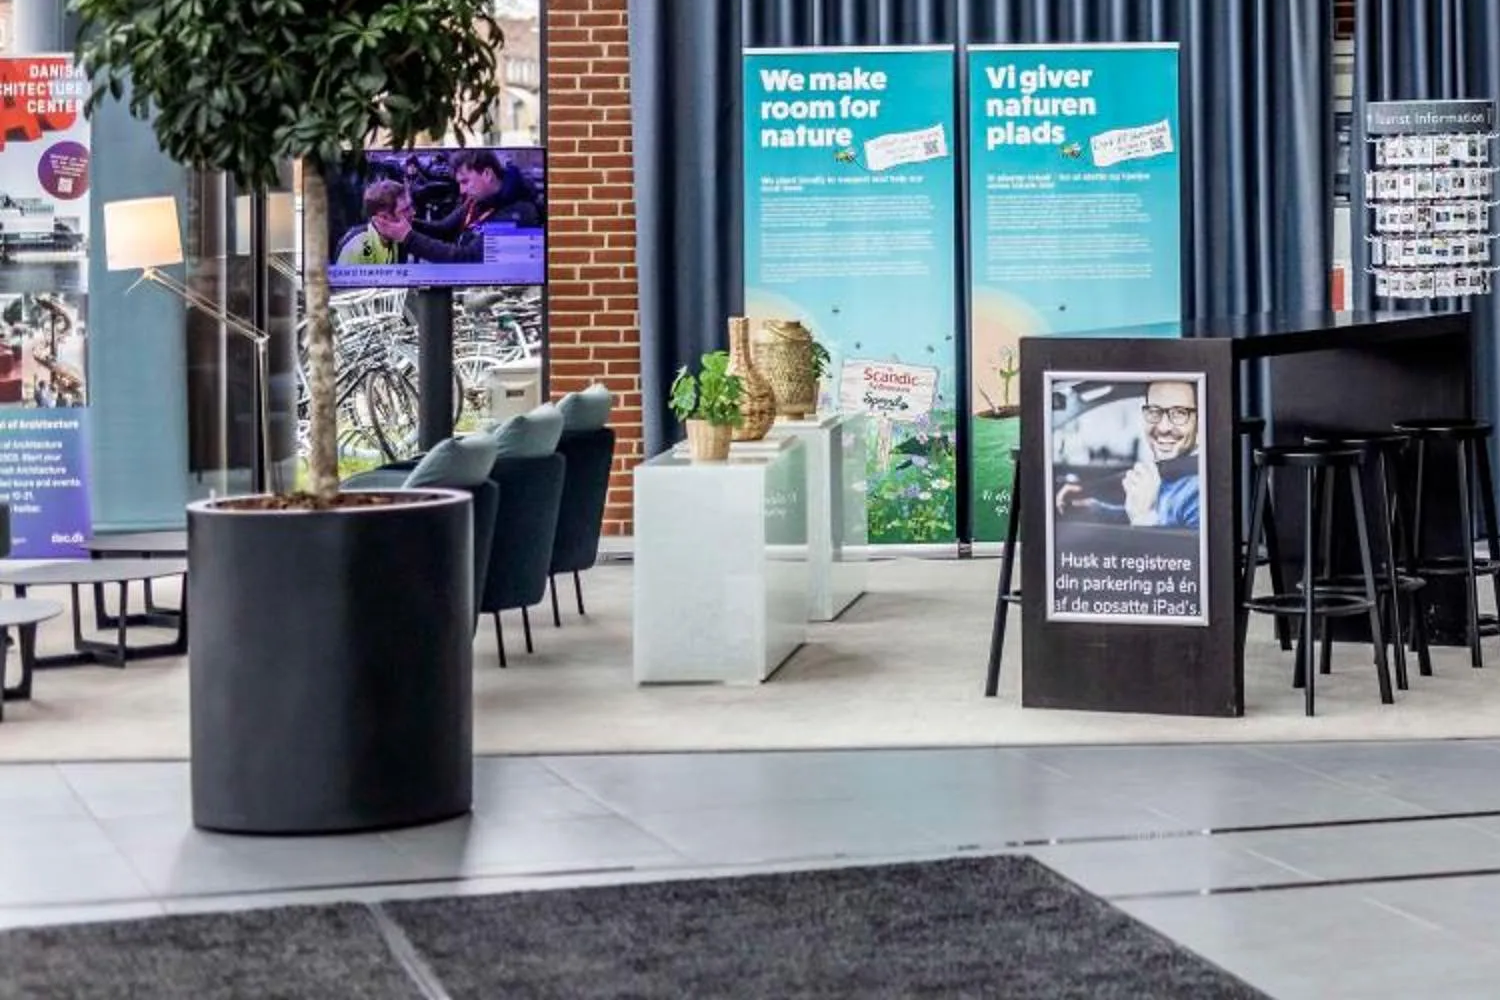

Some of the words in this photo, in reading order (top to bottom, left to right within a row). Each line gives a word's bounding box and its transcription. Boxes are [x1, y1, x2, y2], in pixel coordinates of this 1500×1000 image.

[30, 64, 84, 78] DANISH
[760, 69, 805, 92] We
[809, 67, 888, 91] make
[984, 64, 1016, 89] Vi
[1020, 64, 1093, 94] giver
[0, 82, 83, 97] HITECTURE
[761, 99, 835, 119] room
[840, 95, 881, 118] for
[987, 95, 1097, 117] naturen
[1415, 112, 1485, 124] Information
[761, 125, 852, 147] nature
[987, 121, 1065, 151] plads
[863, 367, 918, 387] Scandic
[1061, 552, 1099, 569] Husk
[1103, 556, 1117, 569] at
[1121, 554, 1192, 573] registrere
[1056, 574, 1079, 590] din
[1083, 575, 1152, 595] parkering
[1156, 576, 1175, 595] på
[1179, 576, 1197, 593] én
[1056, 596, 1067, 611] af
[1072, 597, 1089, 612] de
[1153, 599, 1201, 616] iPad's.
